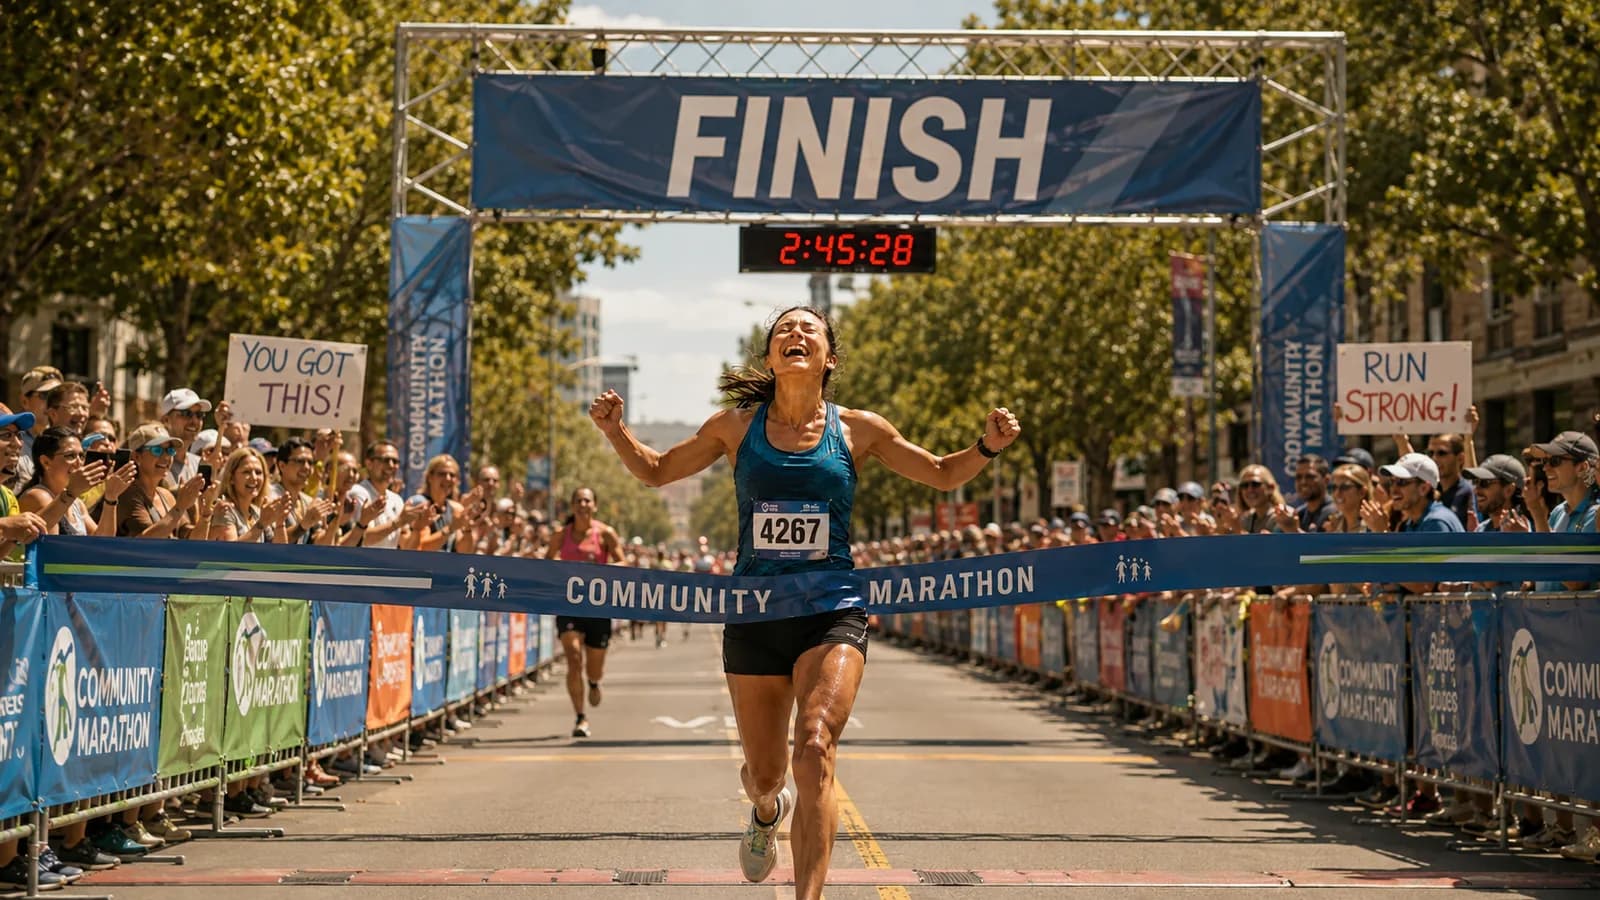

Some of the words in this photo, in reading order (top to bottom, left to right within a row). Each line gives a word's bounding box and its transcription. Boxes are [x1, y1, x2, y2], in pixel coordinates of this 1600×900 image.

[666, 95, 1052, 202] FINISH
[779, 232, 914, 266] 2:45:28
[242, 341, 288, 373] YOU
[297, 347, 354, 378] GOT
[1364, 351, 1427, 383] RUN
[259, 383, 345, 418] THIS!
[428, 338, 447, 437] MATHON
[1305, 343, 1323, 446] MATHON
[1345, 383, 1458, 423] STRONG!
[760, 517, 821, 544] 4267
[566, 576, 772, 614] COMMUNITY
[869, 565, 1034, 605] MARATHON
[77, 667, 155, 708] COMMUNITY
[252, 673, 300, 708] MARATHON
[1339, 659, 1399, 691] COMMUNITY
[1340, 692, 1397, 726] MARATHON
[1547, 704, 1600, 745] MARA
[77, 711, 151, 757] MARATHON
